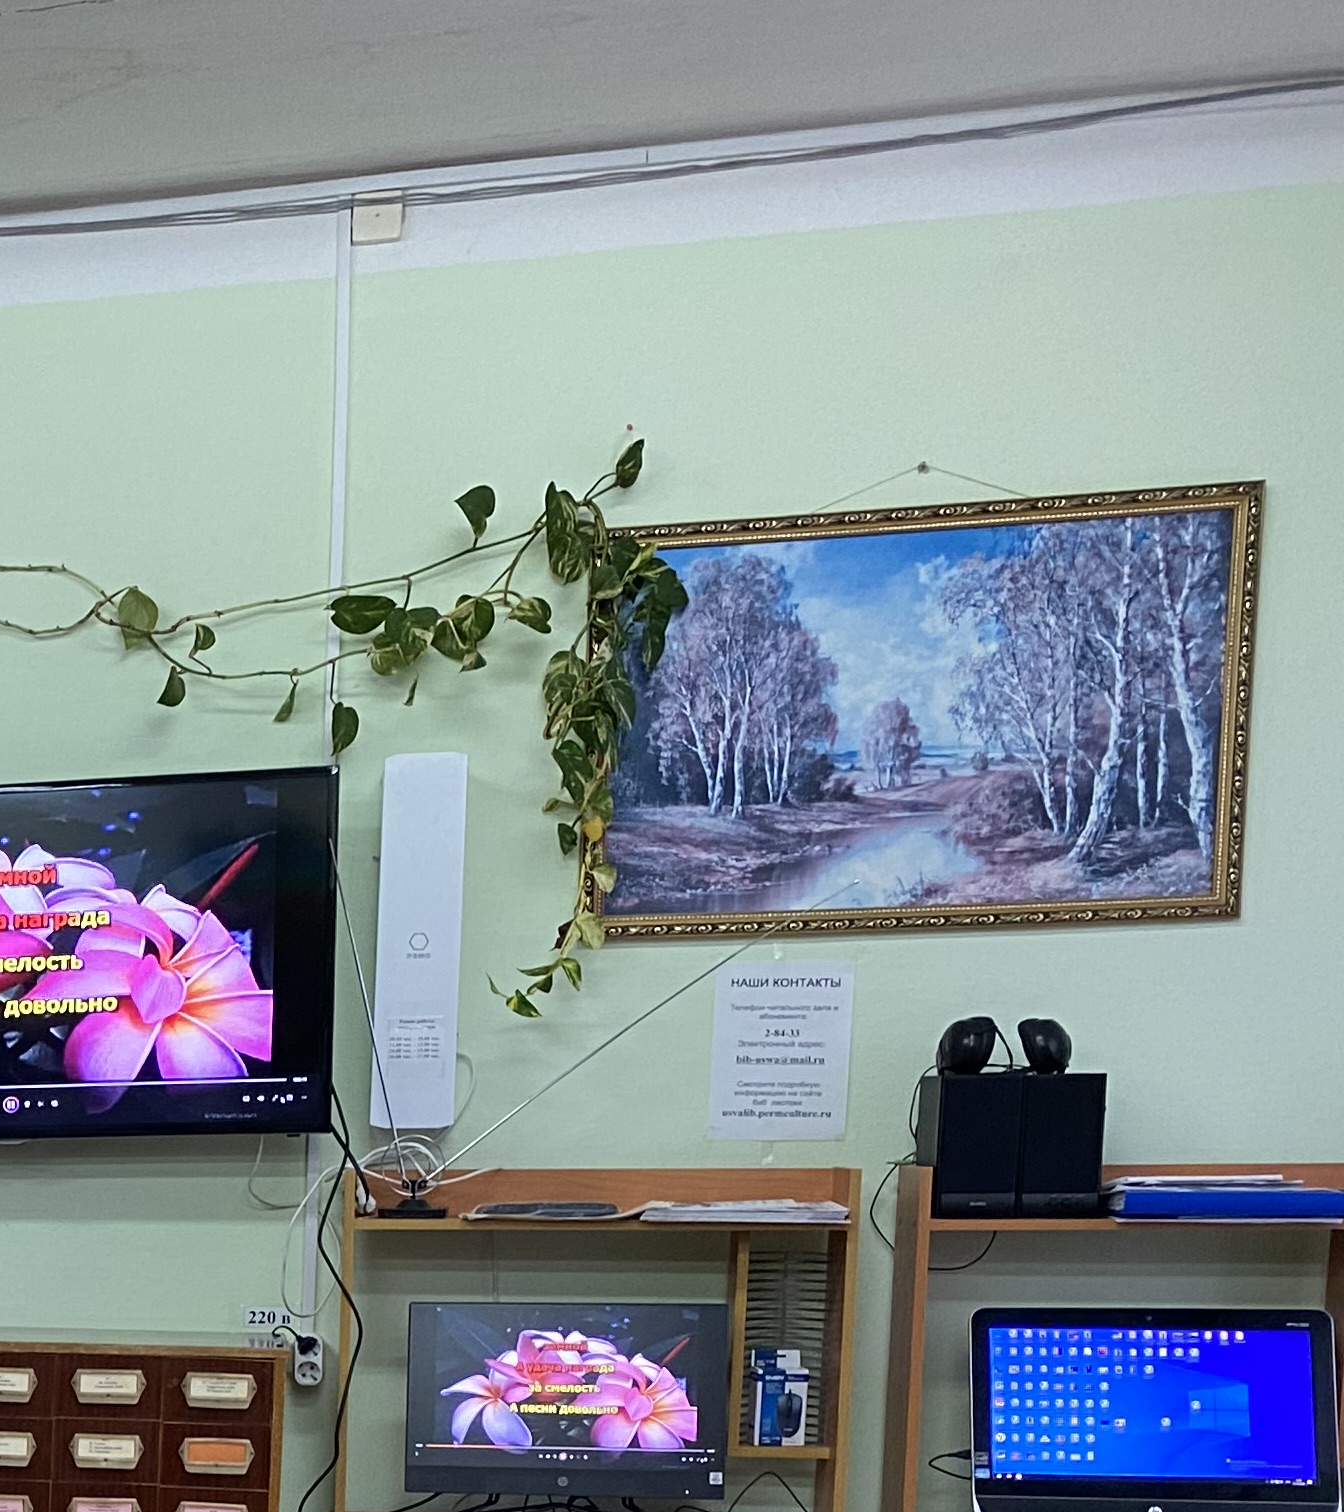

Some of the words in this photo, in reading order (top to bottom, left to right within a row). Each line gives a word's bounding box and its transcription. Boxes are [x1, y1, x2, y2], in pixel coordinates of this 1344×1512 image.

[14, 910, 110, 931] награда
[731, 978, 769, 988] НАШИ
[772, 978, 842, 988] КОНТАКТЫ
[4, 996, 118, 1018] довольно
[764, 1029, 800, 1037] 2-84-33
[248, 1311, 276, 1324] 220
[528, 1363, 563, 1373] удача
[565, 1364, 615, 1374] награда
[544, 1385, 601, 1393] смелость
[509, 1402, 519, 1413] А
[520, 1404, 557, 1414] песни
[559, 1404, 619, 1415] довольно
